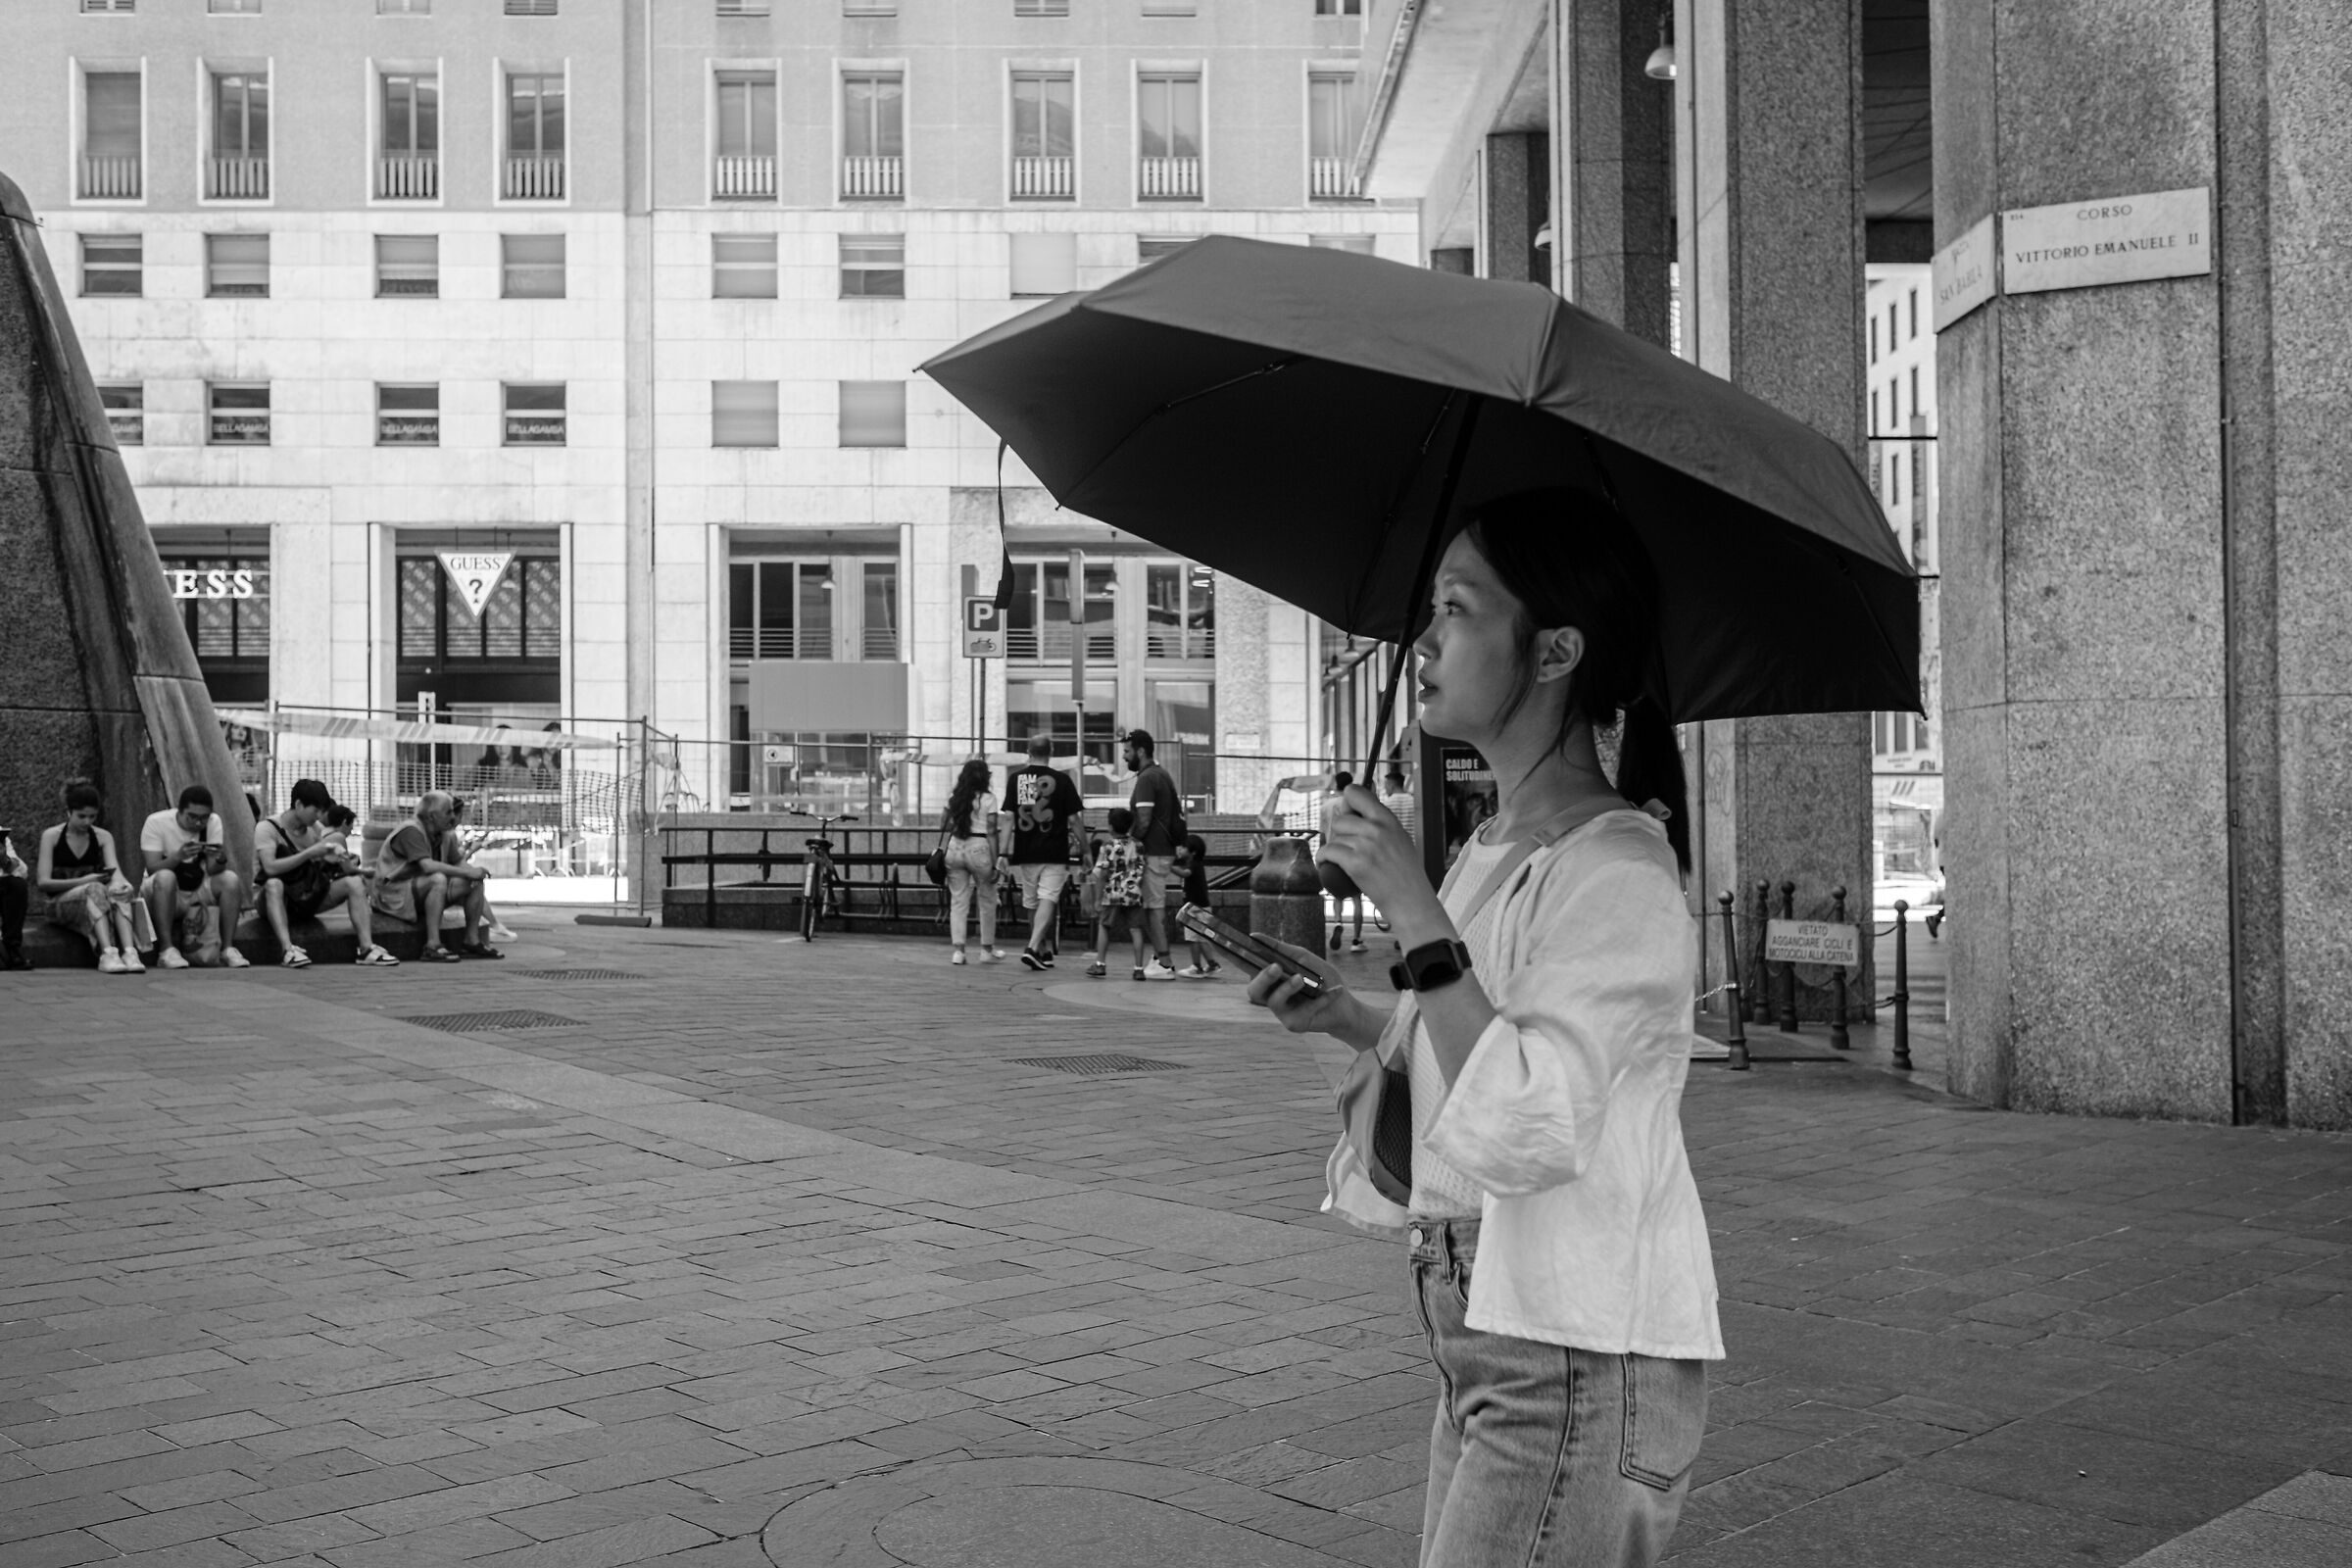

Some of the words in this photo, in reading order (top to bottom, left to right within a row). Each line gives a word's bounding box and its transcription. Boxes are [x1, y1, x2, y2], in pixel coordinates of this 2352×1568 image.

[2077, 204, 2132, 220] CORSO
[2016, 246, 2089, 264] VITTORIO
[2094, 235, 2177, 256] EMANUELE
[2188, 233, 2198, 246] II
[451, 557, 501, 570] GUESS
[164, 568, 254, 599] ESS
[974, 603, 994, 628] P
[1446, 759, 1473, 770] CALDO
[1473, 759, 1479, 769] E
[1798, 924, 1829, 937] VIETATO
